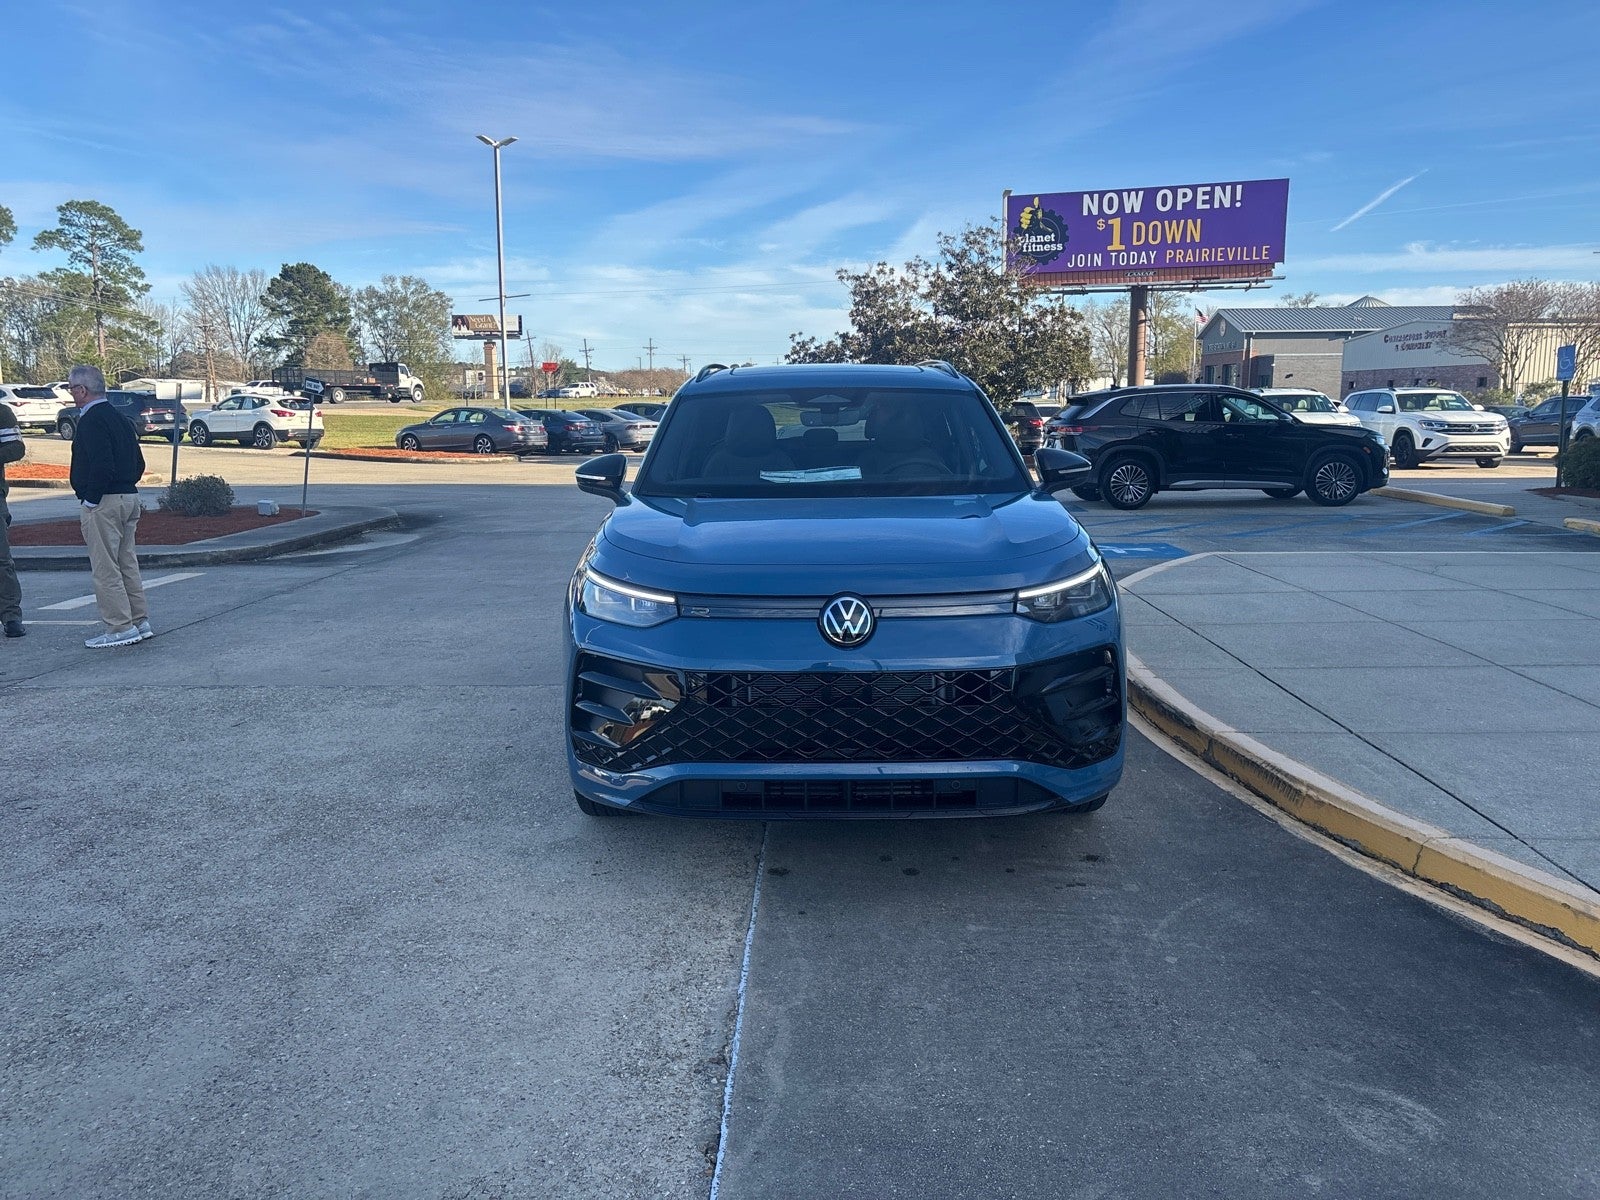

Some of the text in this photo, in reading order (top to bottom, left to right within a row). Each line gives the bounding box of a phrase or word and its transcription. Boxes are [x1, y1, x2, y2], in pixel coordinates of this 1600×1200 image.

[1082, 184, 1243, 216] NOW OPEN!
[1132, 218, 1201, 246] DOWN
[1022, 242, 1063, 253] fitness
[1067, 245, 1271, 268] JOIN TODAY PRAIRIEVILLE
